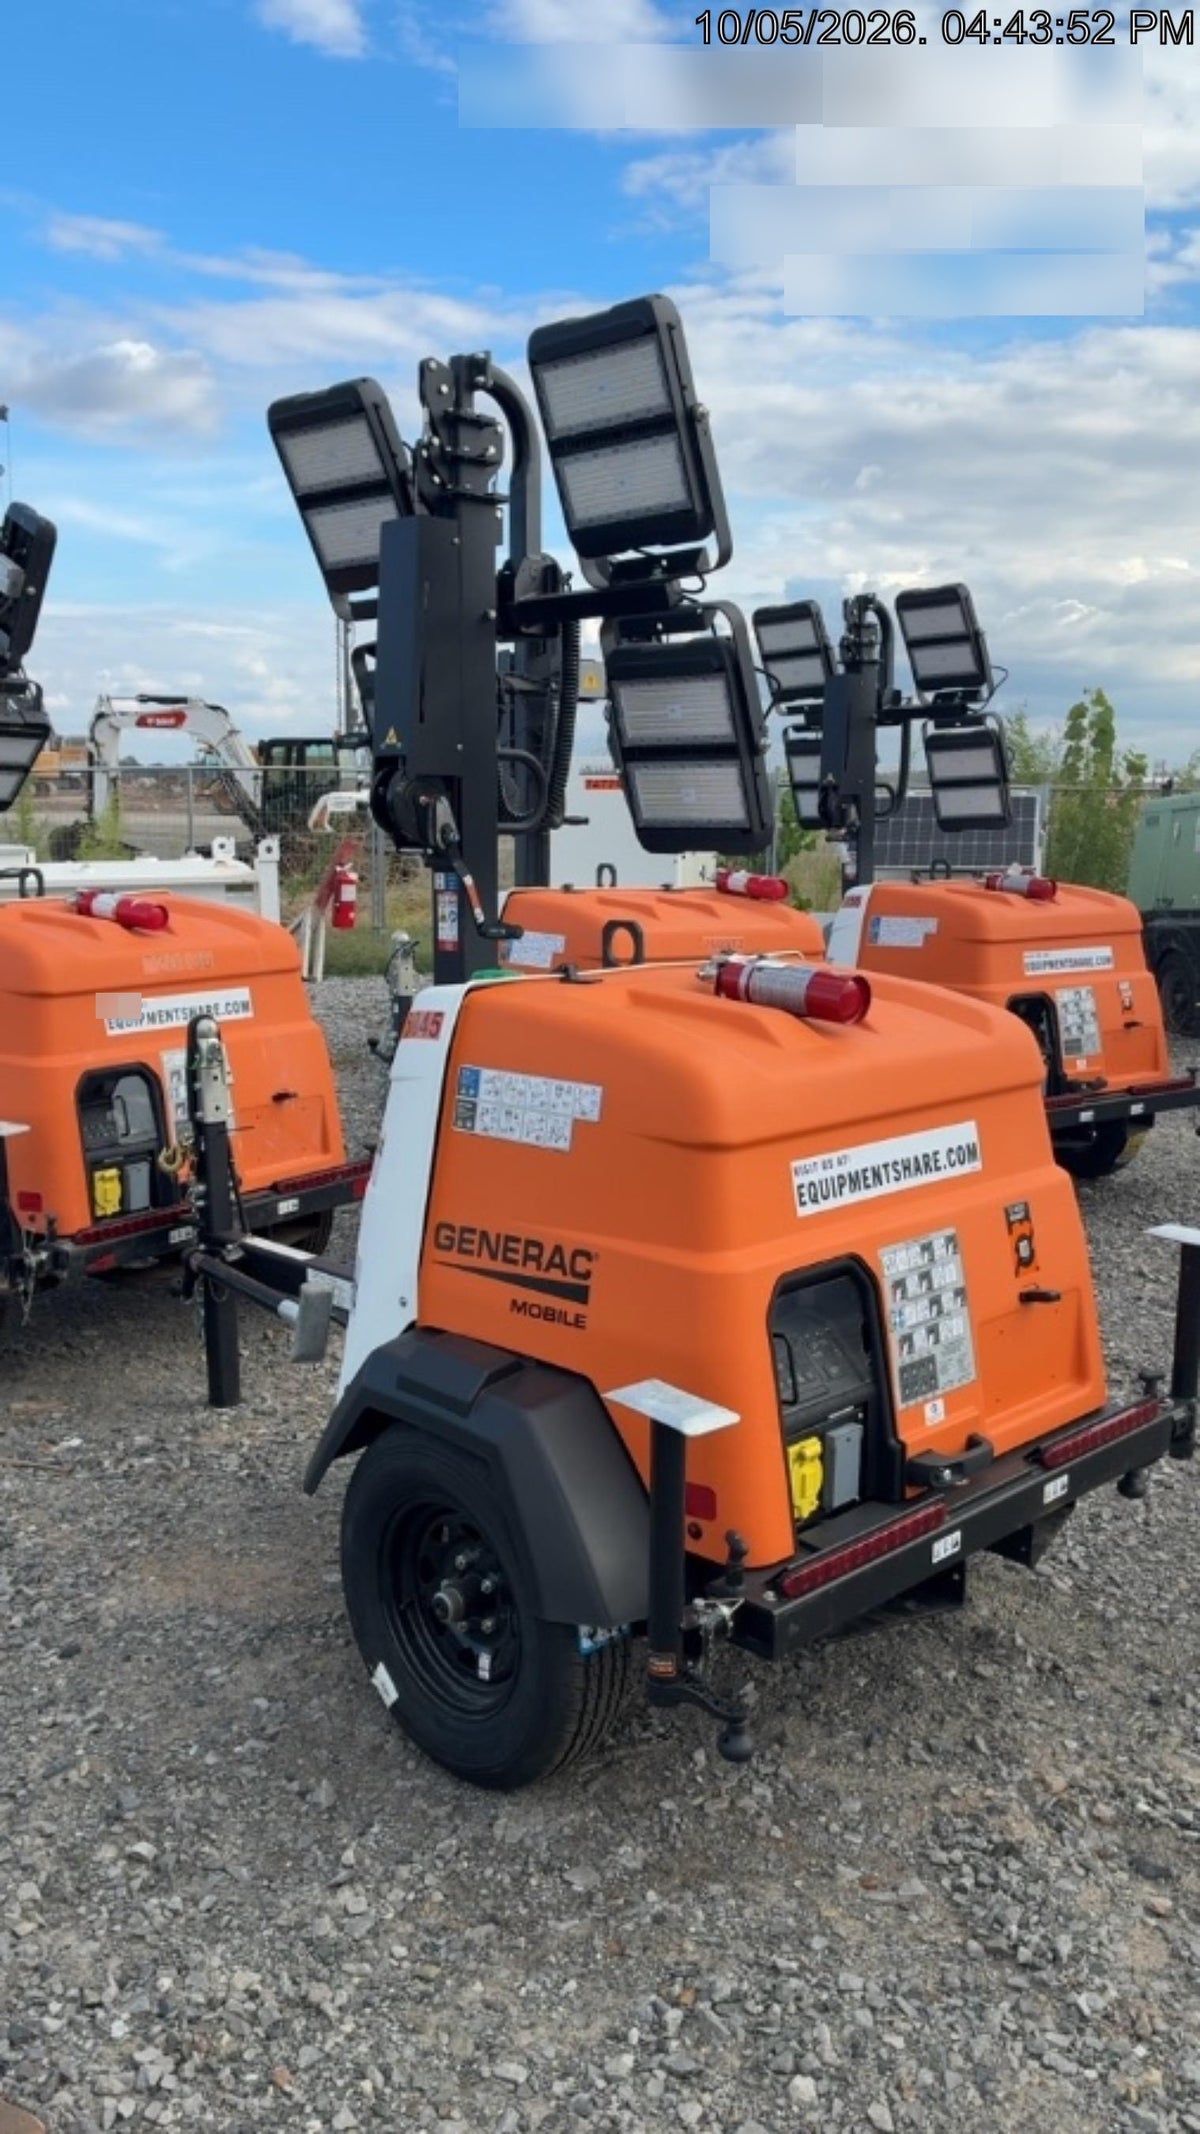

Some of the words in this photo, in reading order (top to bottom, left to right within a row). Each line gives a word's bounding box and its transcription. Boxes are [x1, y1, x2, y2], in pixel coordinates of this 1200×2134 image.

[796, 1141, 979, 1208] EQUIPMENTSHARE.COM
[433, 1220, 594, 1281] GENERAC
[510, 1298, 587, 1330] MOBILE
